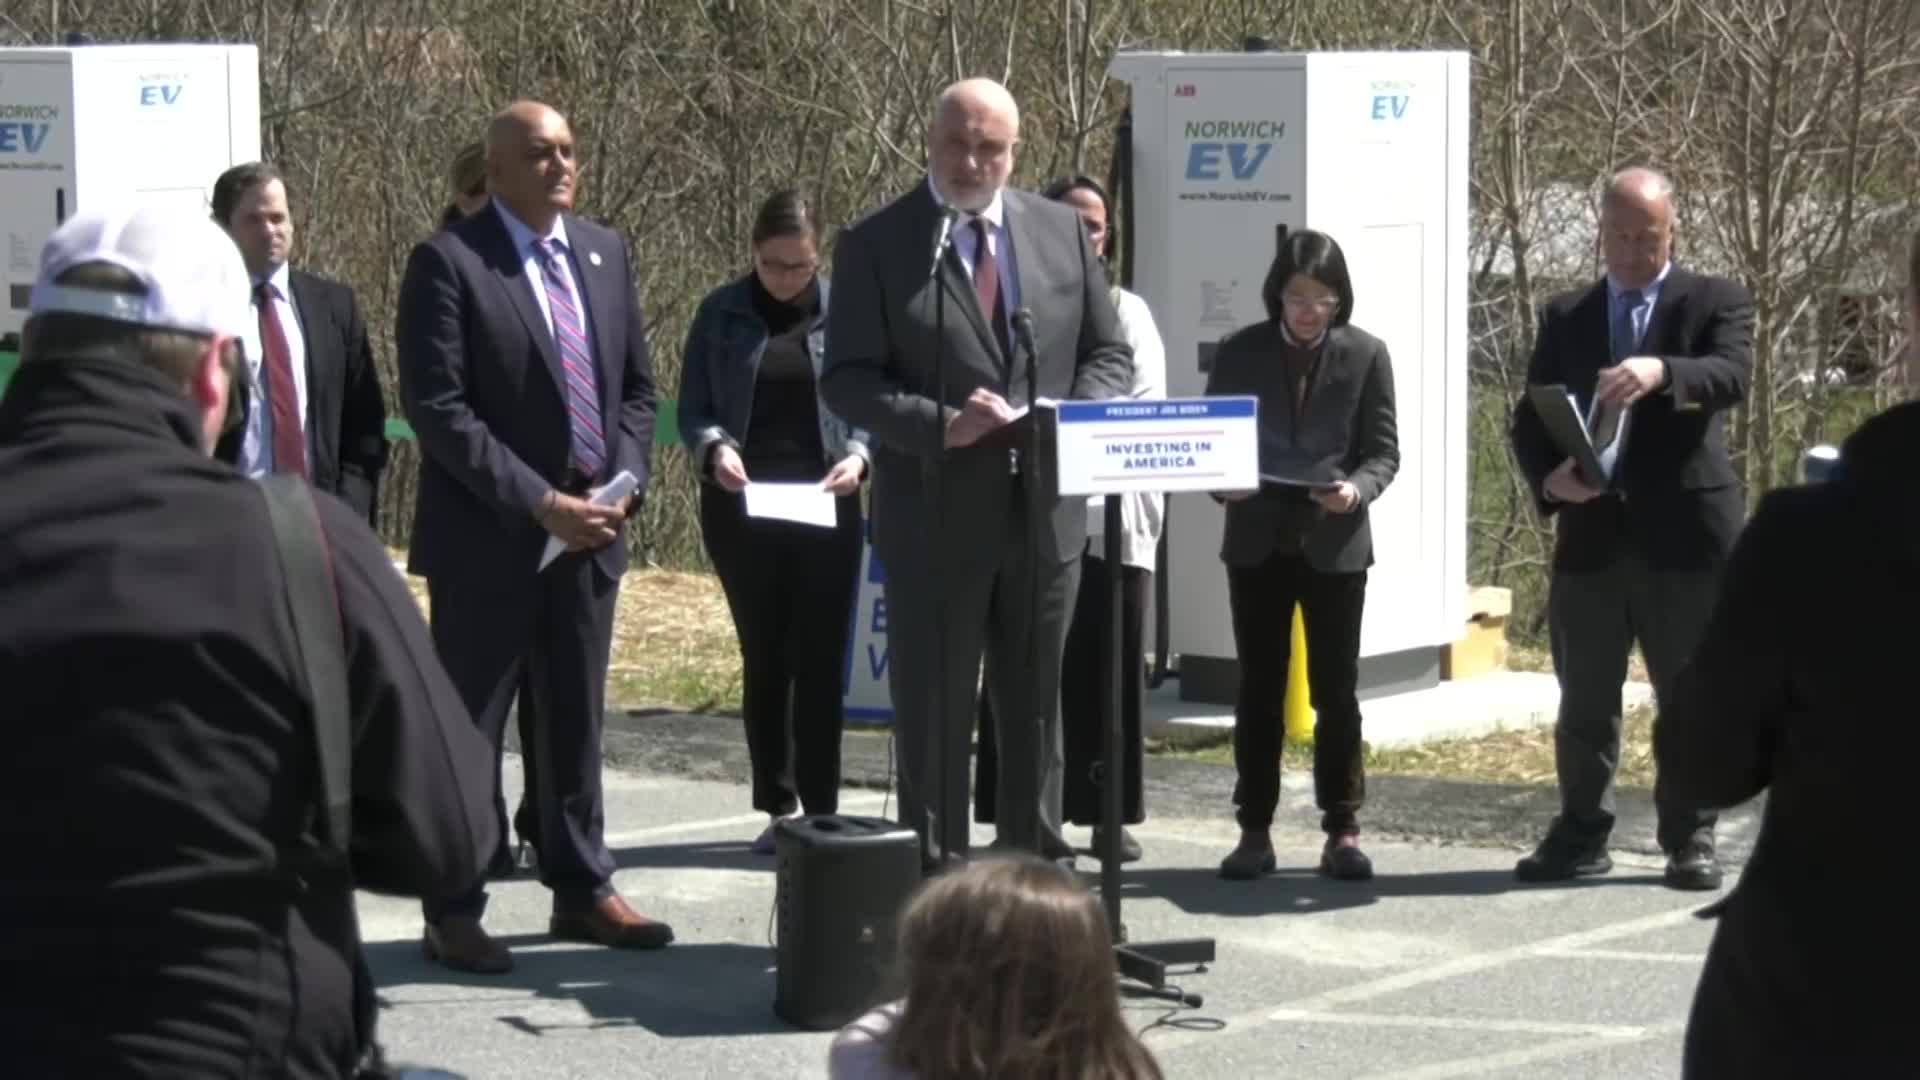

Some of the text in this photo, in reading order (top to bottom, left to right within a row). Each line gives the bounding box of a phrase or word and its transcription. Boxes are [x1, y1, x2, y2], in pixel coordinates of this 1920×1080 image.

[140, 85, 183, 106] EV
[1371, 95, 1410, 120] EV
[0, 122, 49, 153] EV
[1184, 120, 1286, 138] NORWICH
[1184, 143, 1273, 180] EV
[1105, 440, 1211, 455] INVESTING IN
[1123, 455, 1196, 469] AMERICA
